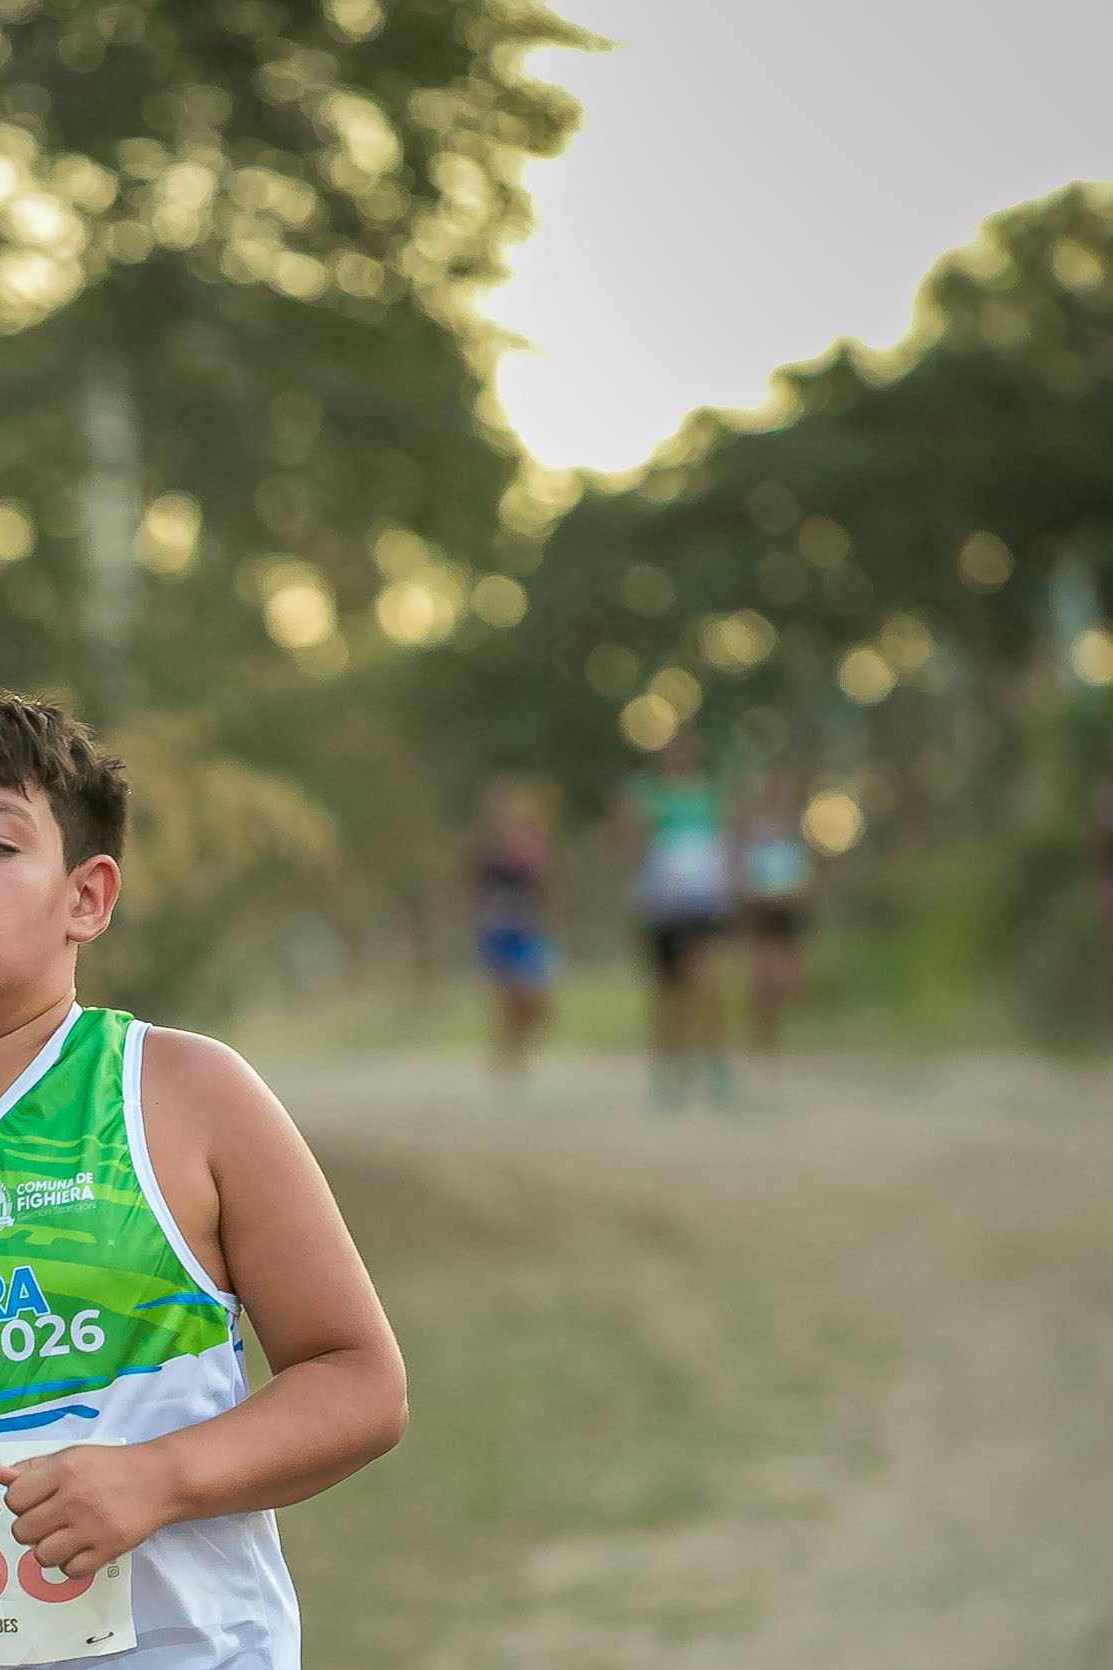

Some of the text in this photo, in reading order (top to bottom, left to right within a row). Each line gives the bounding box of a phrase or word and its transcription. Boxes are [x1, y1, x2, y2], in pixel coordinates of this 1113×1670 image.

[16, 1172, 94, 1195] COMUNA DE
[17, 1185, 95, 1212] FIGHIERA
